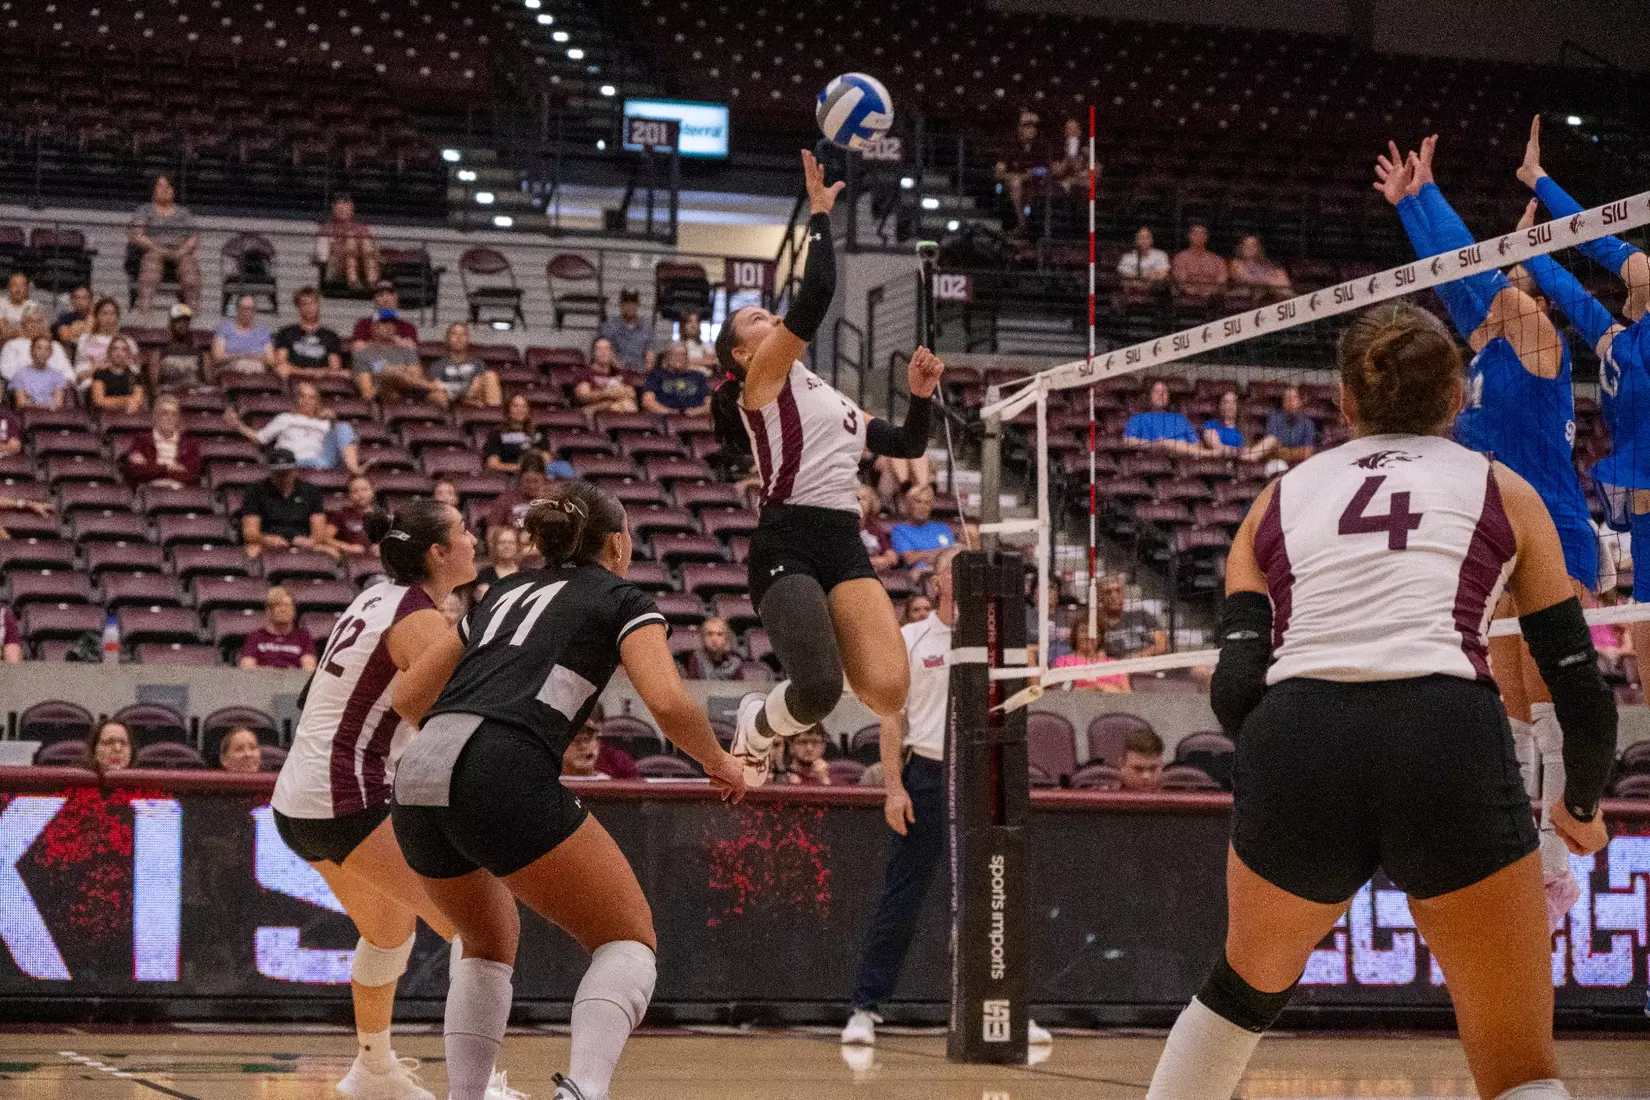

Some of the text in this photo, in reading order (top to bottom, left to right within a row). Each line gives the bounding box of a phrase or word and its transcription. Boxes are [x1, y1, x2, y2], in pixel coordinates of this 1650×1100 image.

[632, 121, 668, 145] 201
[861, 137, 900, 160] 202
[733, 262, 764, 287] 101
[932, 274, 967, 299] 102
[1125, 349, 1141, 365] SIU
[1172, 334, 1190, 352] SIU
[1223, 318, 1242, 337] SIU
[1277, 302, 1296, 322] SIU
[1333, 284, 1354, 304] SIU
[1394, 267, 1416, 288] SIU
[1458, 247, 1482, 268] SIU
[1527, 225, 1552, 247] SIU
[1601, 202, 1628, 225] SIU
[1338, 475, 1424, 551] 4
[477, 580, 569, 648] 11
[320, 615, 366, 678] 12
[989, 855, 1006, 910] sports
[989, 912, 1006, 980] imports
